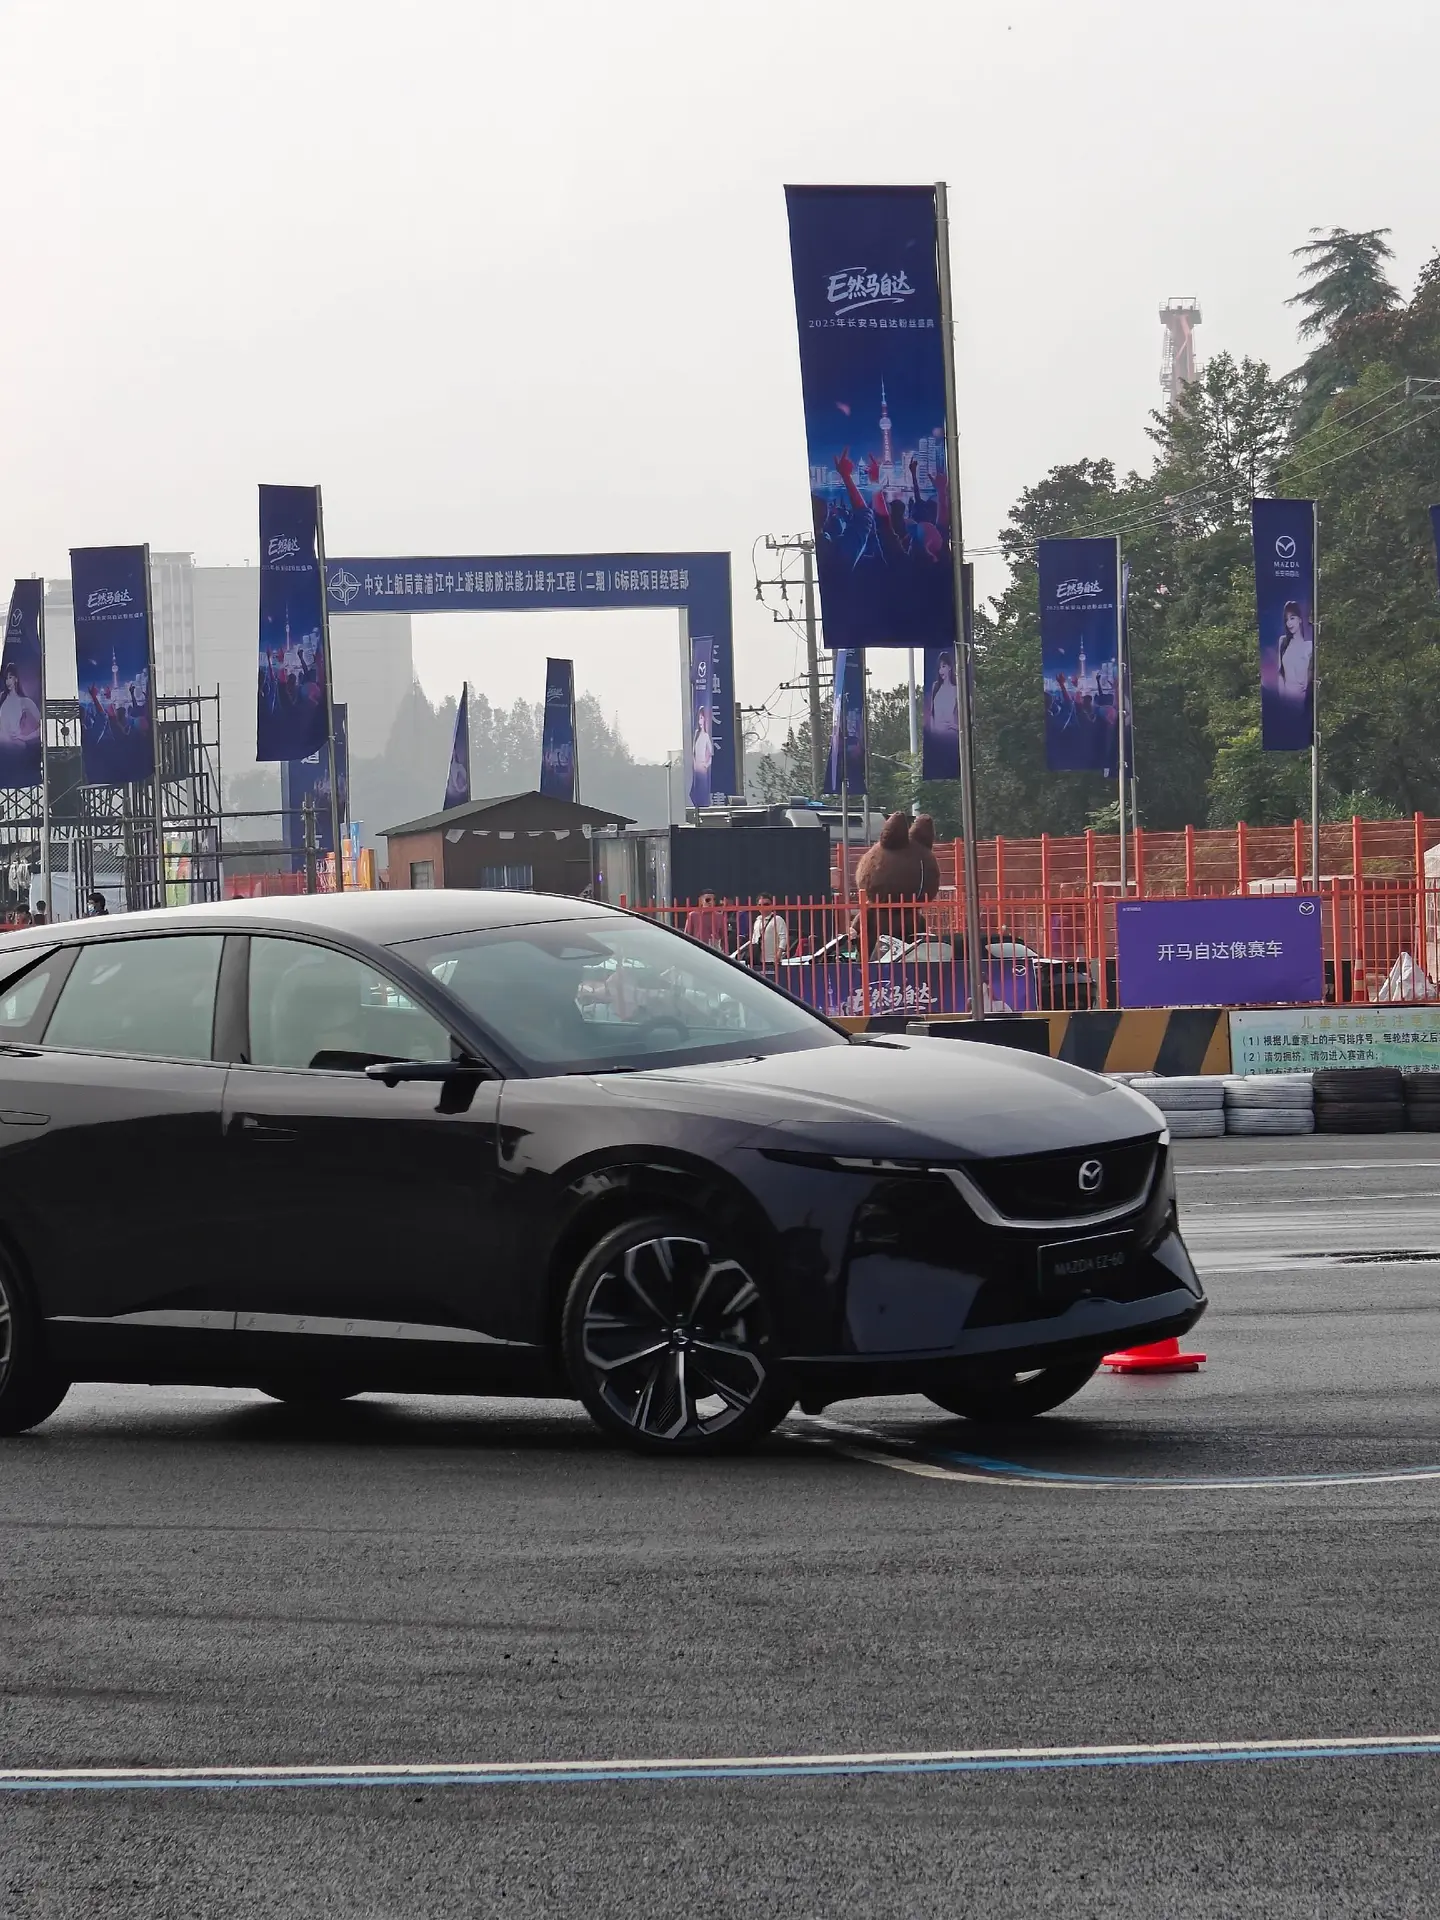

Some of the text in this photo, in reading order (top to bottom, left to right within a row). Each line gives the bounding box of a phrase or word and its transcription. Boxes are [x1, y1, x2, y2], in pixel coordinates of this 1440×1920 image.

[826, 270, 916, 303] E然马自达
[808, 318, 935, 328] 2025年长安马自达粉丝盛典
[1157, 940, 1284, 961] 开马自达像赛车
[1054, 1252, 1125, 1275] MAZDA EZ-60
